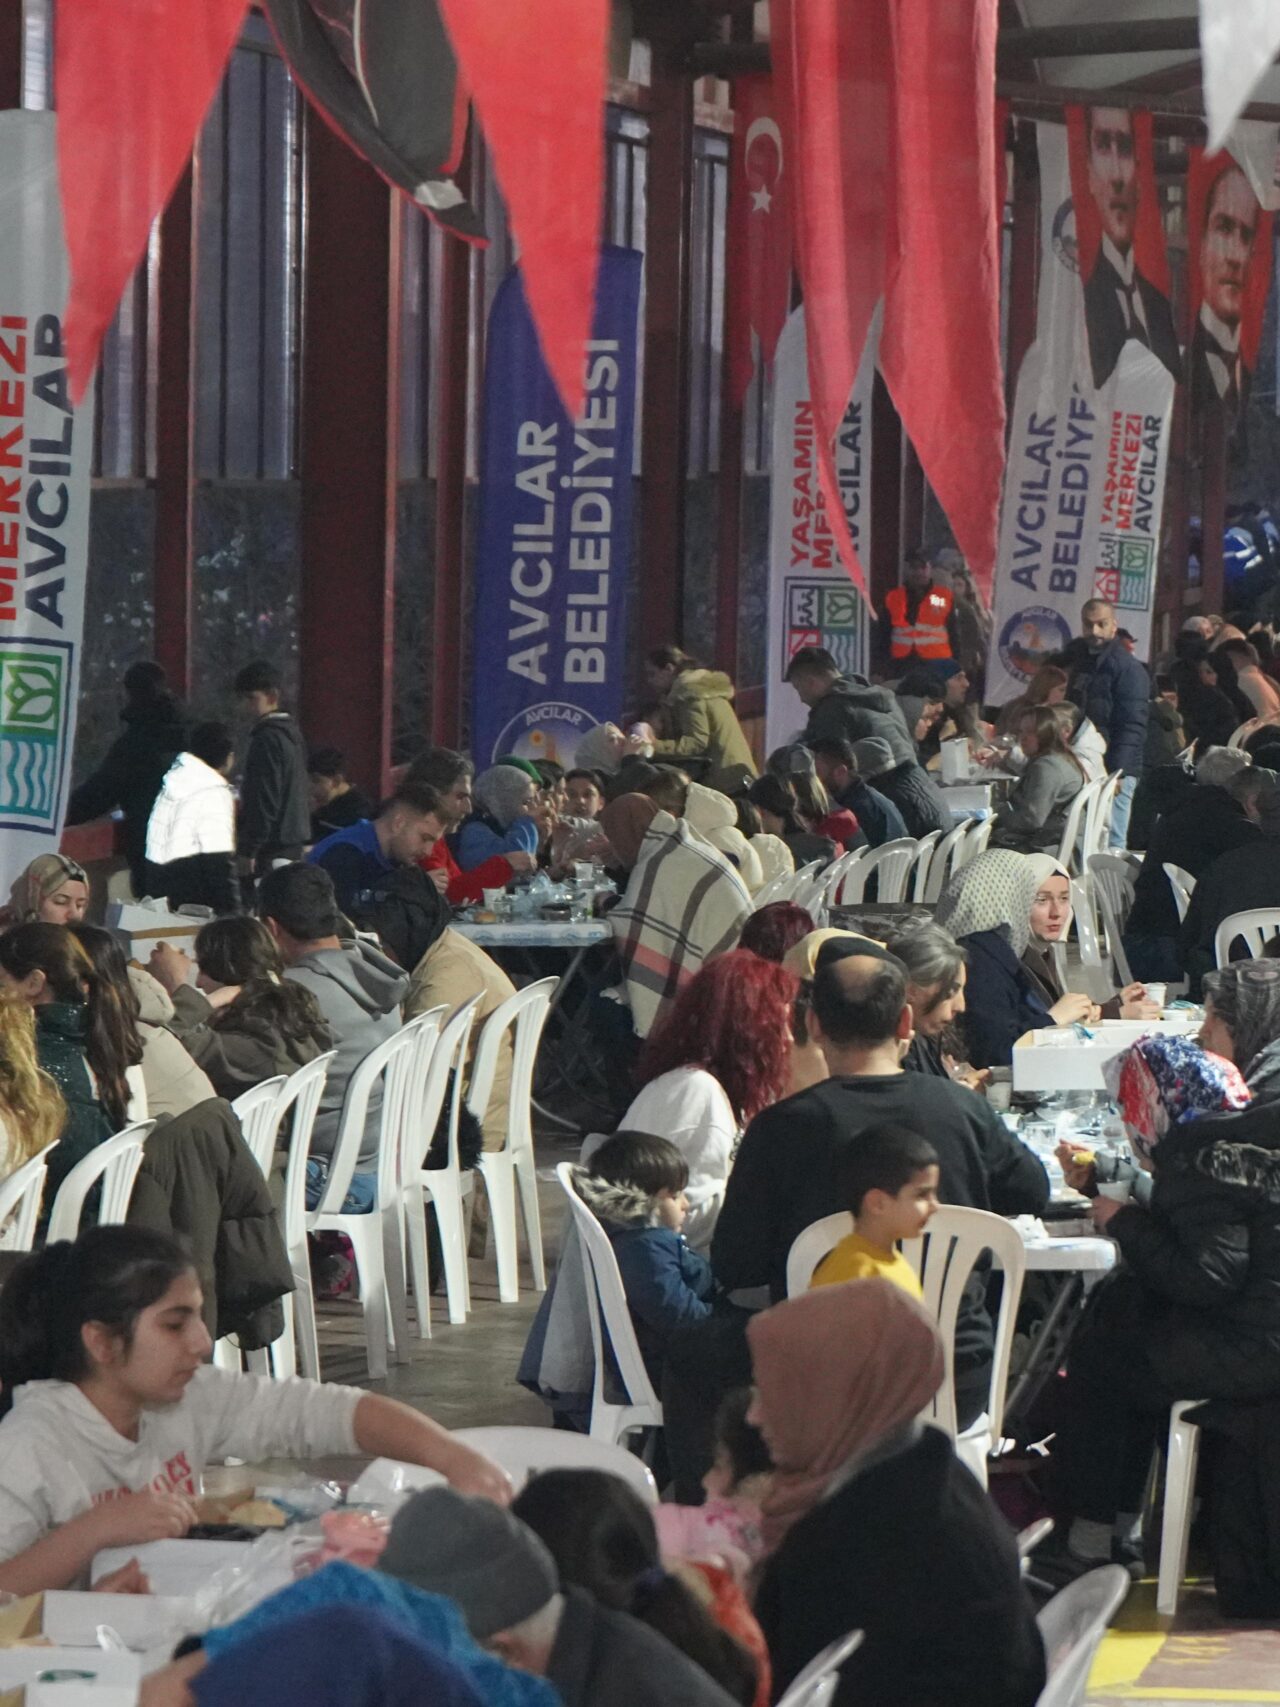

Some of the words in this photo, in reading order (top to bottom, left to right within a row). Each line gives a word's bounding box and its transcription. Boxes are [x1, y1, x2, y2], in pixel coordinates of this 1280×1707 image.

[24, 314, 74, 629] AVCILAR
[506, 420, 559, 686] AVCILAR
[791, 401, 814, 568] YAŞAMIN
[1009, 411, 1058, 592] AVCILAR
[1133, 414, 1163, 533] AVCILAR
[525, 706, 583, 726] AVCILAR
